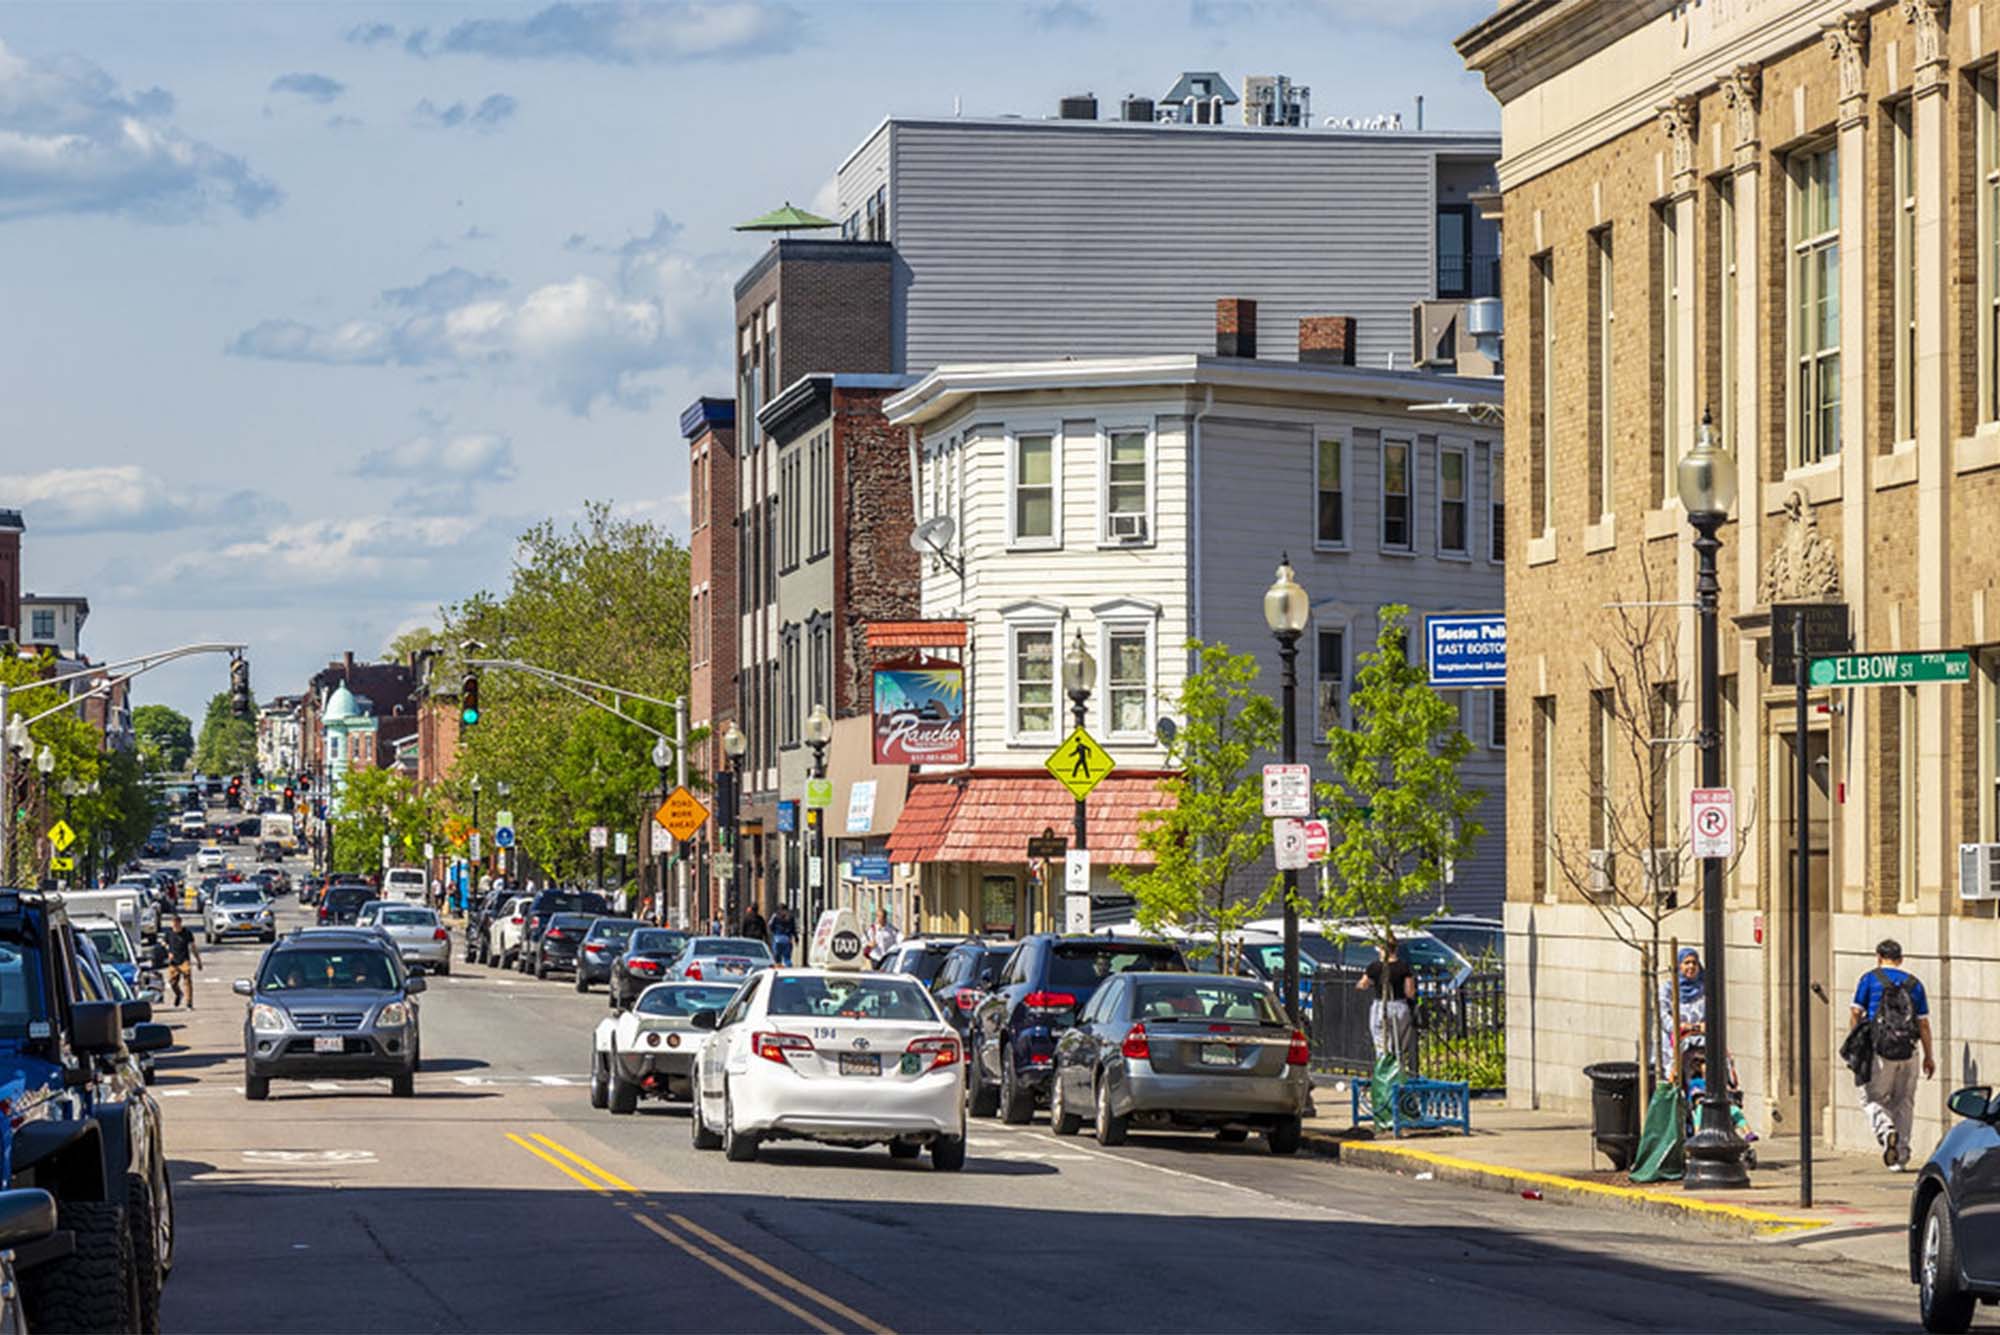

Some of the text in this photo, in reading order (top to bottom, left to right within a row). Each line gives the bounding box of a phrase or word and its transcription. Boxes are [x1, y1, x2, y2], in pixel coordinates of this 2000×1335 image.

[1436, 626, 1478, 640] Boston
[1437, 644, 1464, 655] EAST
[1836, 656, 1898, 680] ELBOW
[1945, 661, 1967, 675] WAY
[882, 713, 960, 757] Rancho
[834, 938, 858, 953] TAXI
